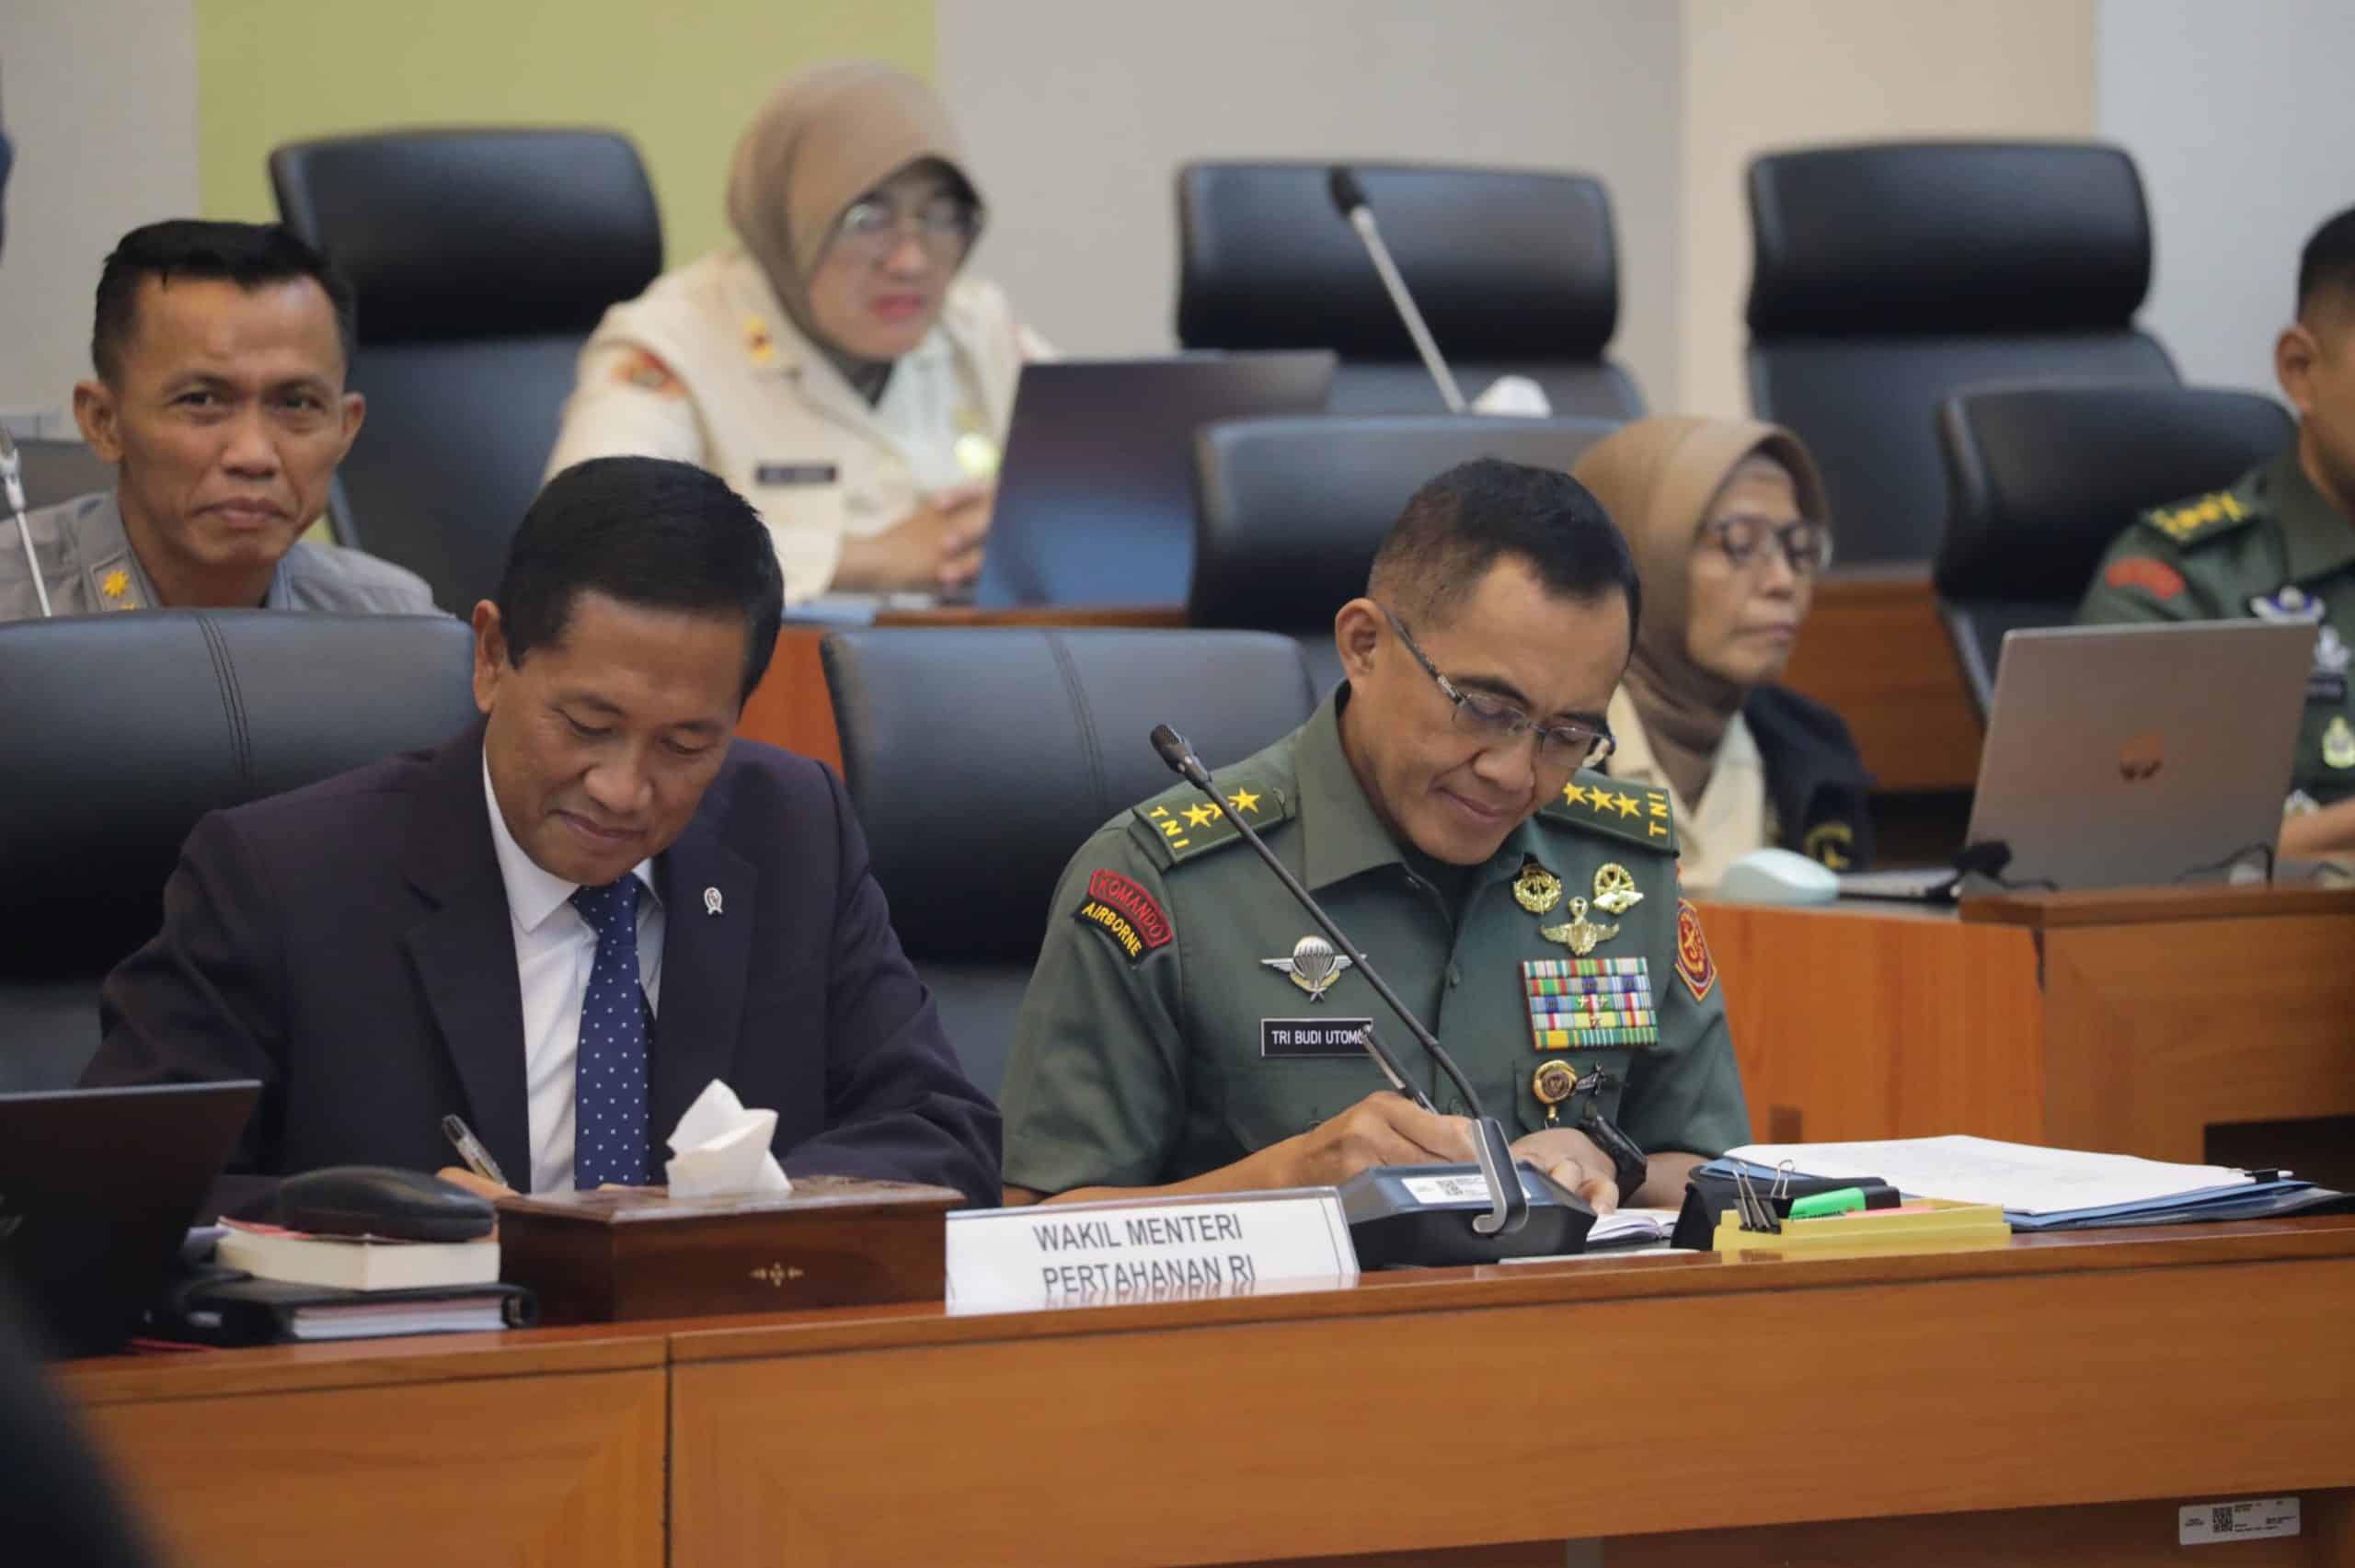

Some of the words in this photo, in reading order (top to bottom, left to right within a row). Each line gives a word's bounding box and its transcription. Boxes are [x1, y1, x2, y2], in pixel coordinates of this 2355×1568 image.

[1150, 806, 1189, 849] TNI
[1648, 793, 1668, 837] TNI
[1082, 902, 1142, 956] AIRBORNE
[1096, 878, 1164, 937] KOMANDO
[1271, 1030, 1291, 1045] TRI
[1294, 1030, 1322, 1045] BUDI
[1032, 1221, 1121, 1252] WAKIL
[1126, 1213, 1243, 1246] MENTERI
[1042, 1255, 1222, 1293] PERTAHANAN
[1229, 1254, 1257, 1282] RI
